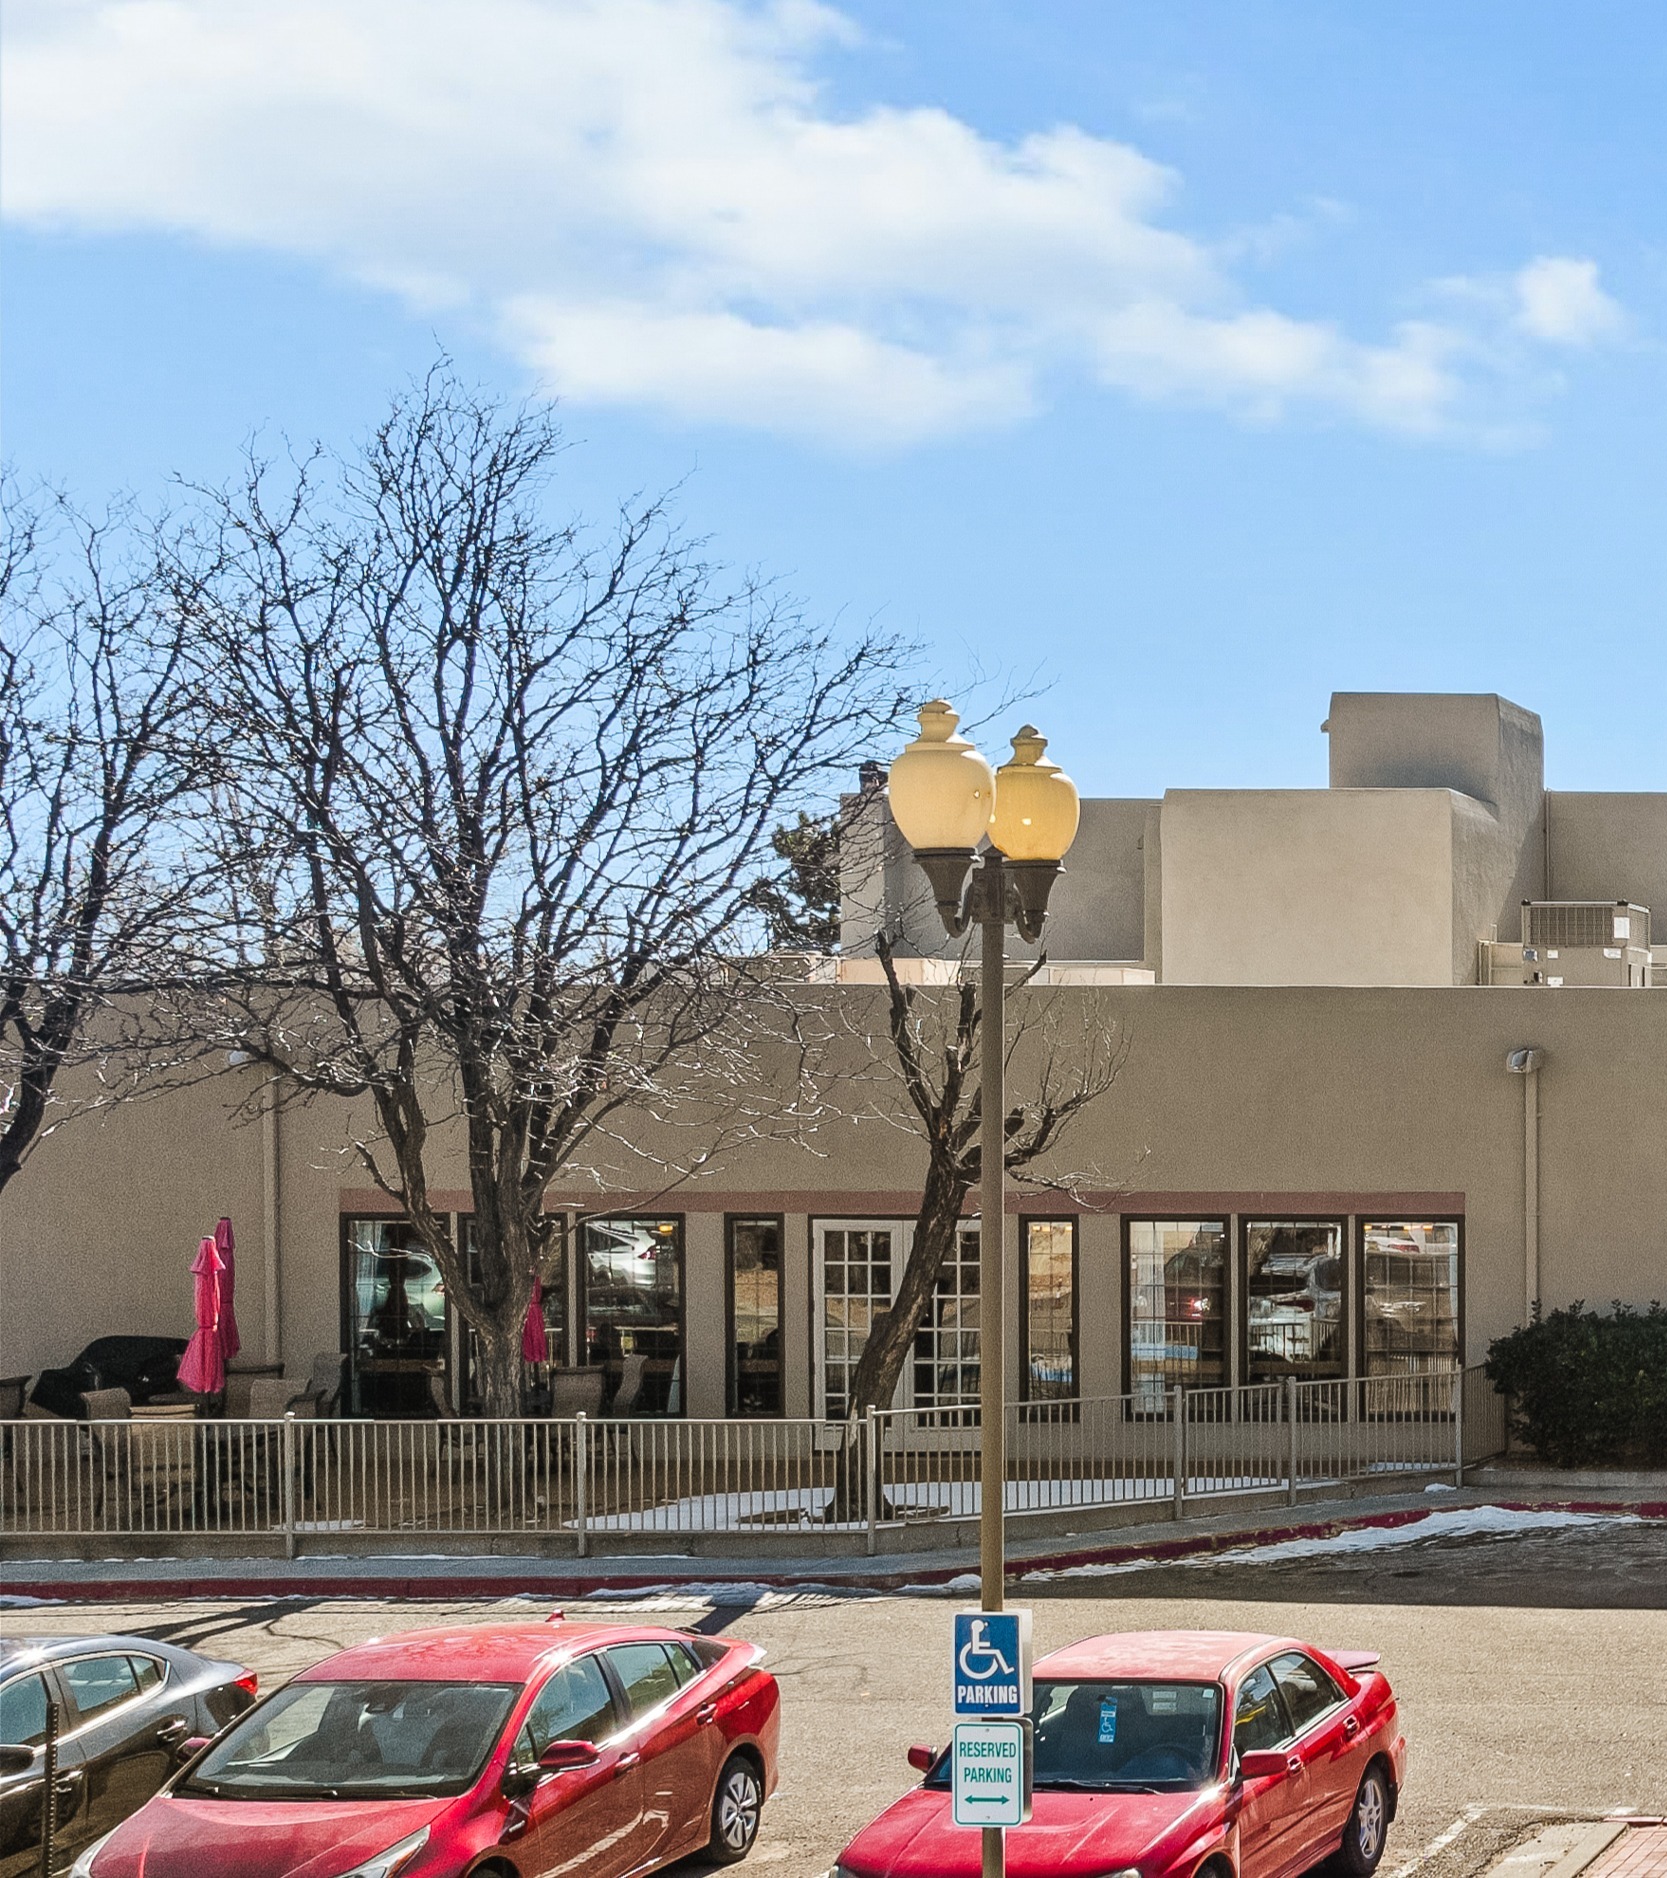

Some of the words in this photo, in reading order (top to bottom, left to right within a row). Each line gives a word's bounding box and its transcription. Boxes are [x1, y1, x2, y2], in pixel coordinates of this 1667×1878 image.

[957, 1685, 1018, 1704] PARKING
[959, 1741, 1017, 1758] RESERVED
[963, 1767, 1012, 1783] PARKING
